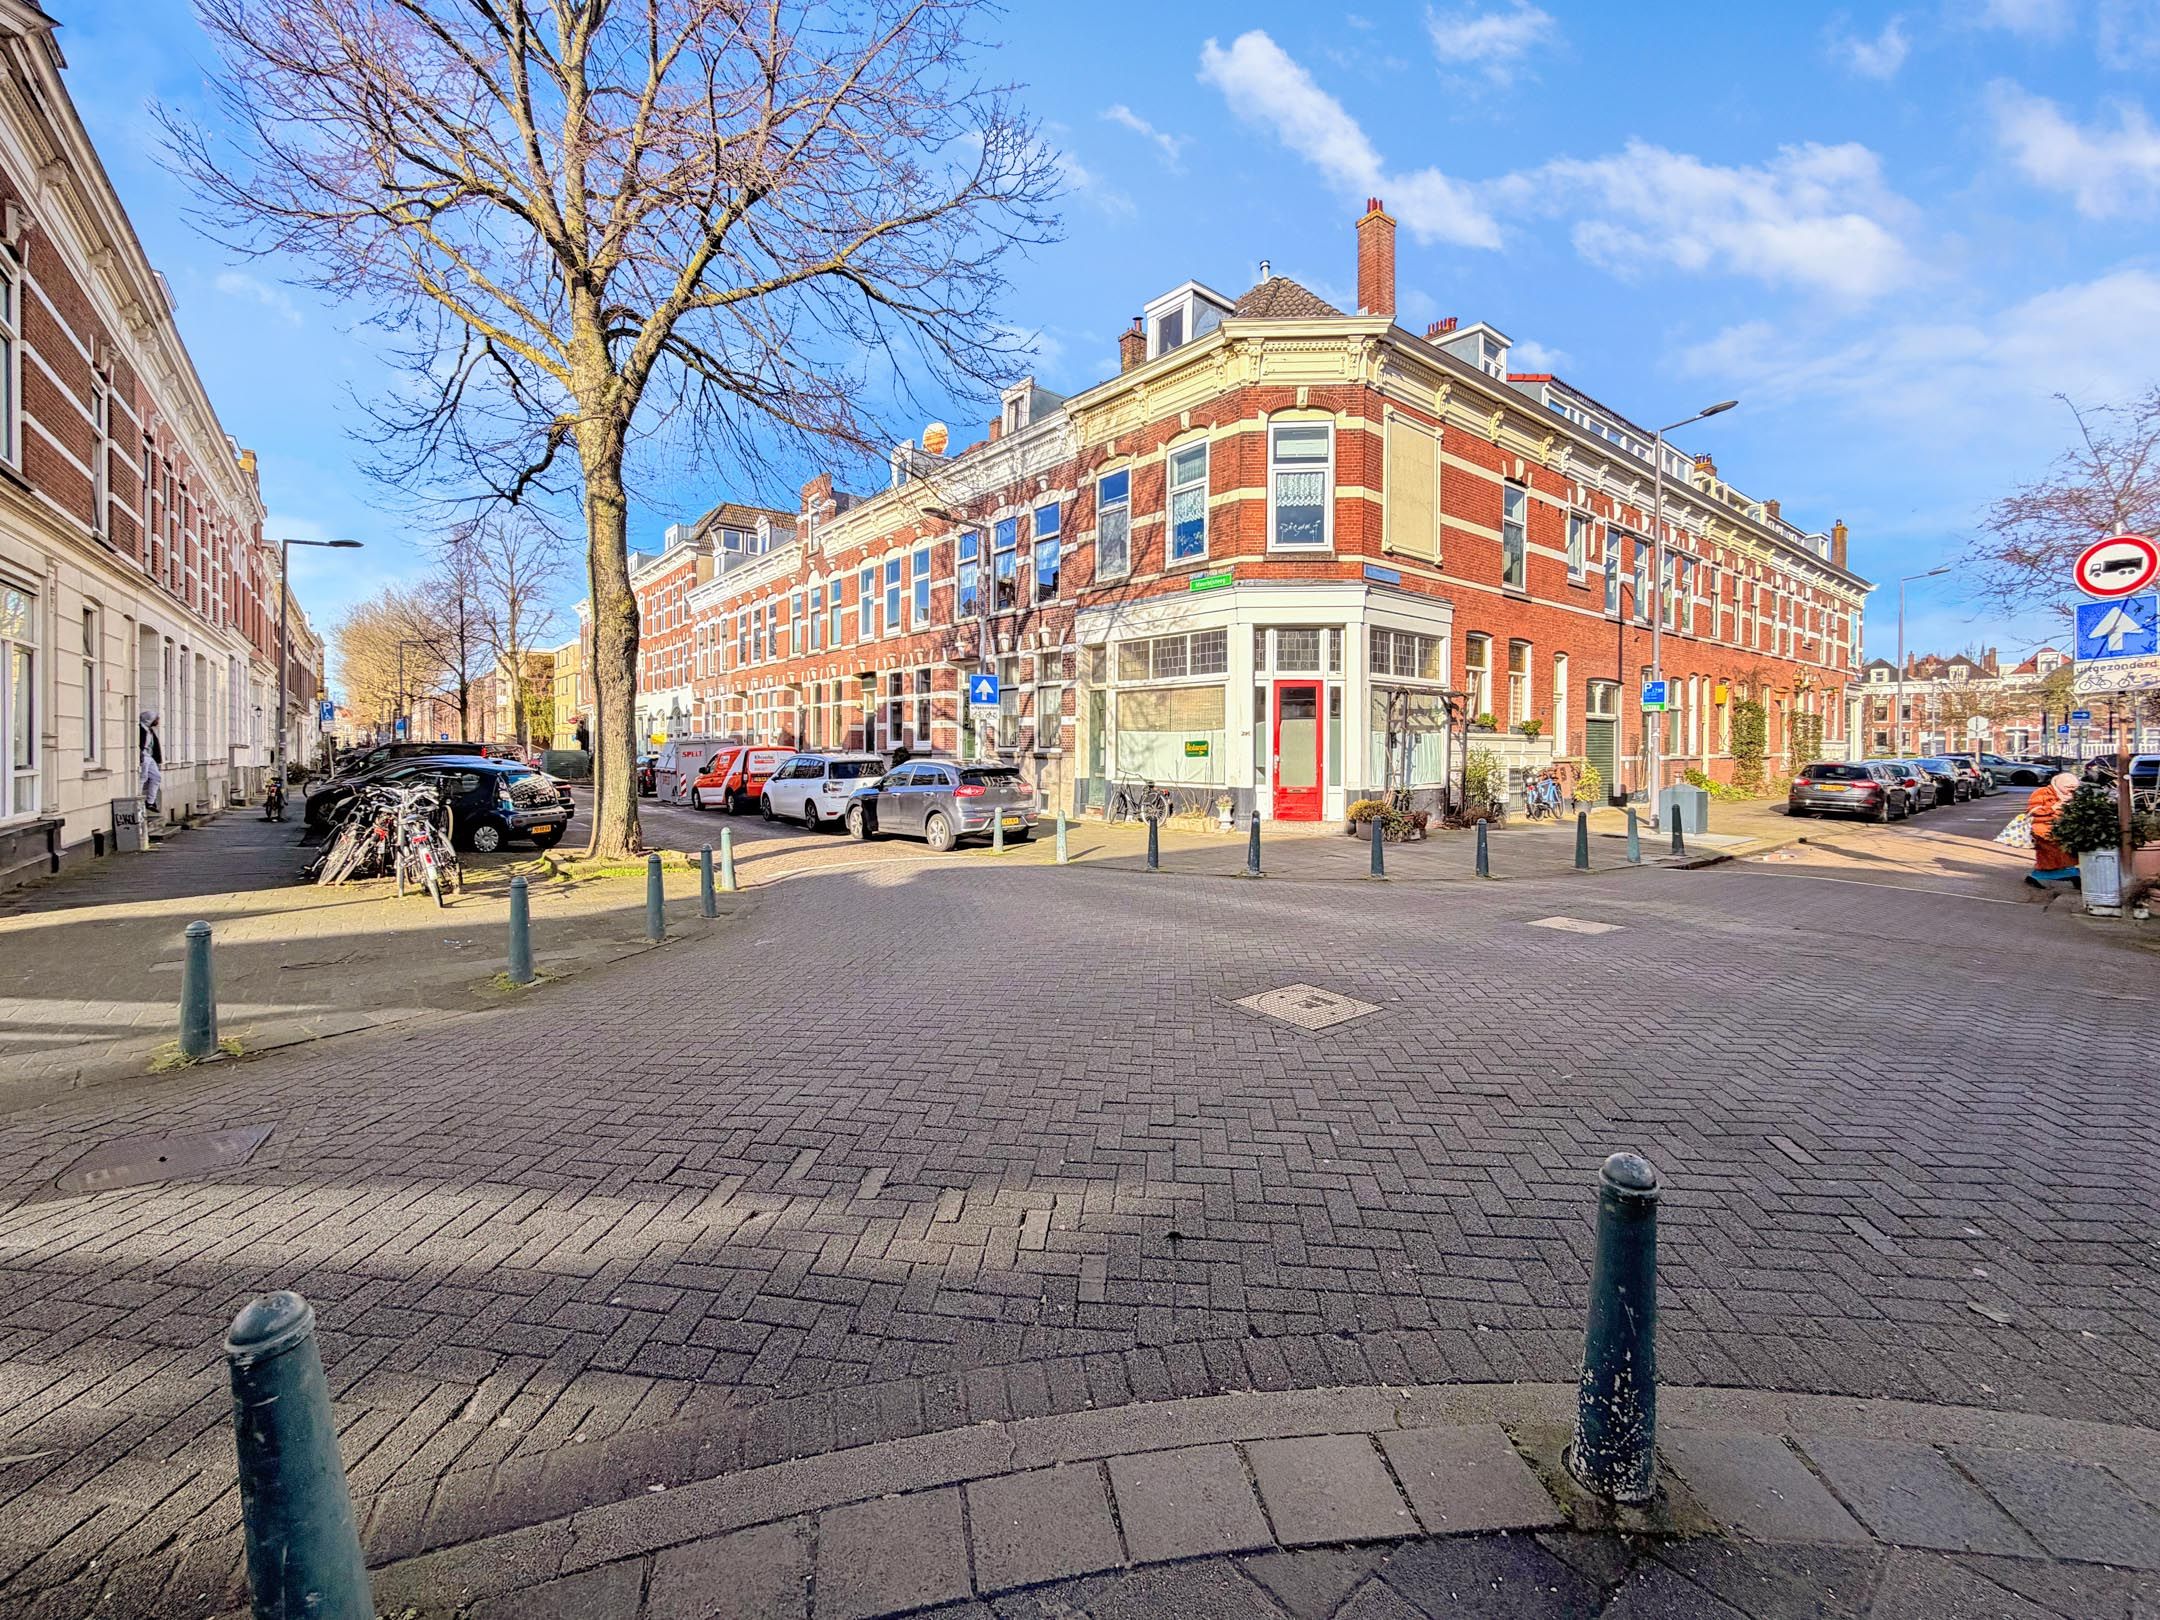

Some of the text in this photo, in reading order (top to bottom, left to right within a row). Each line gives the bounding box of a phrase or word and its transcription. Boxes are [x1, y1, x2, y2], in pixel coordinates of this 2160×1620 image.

[2076, 659, 2157, 674] uitgezonderd
[1645, 683, 1652, 692] P
[323, 702, 331, 713] P
